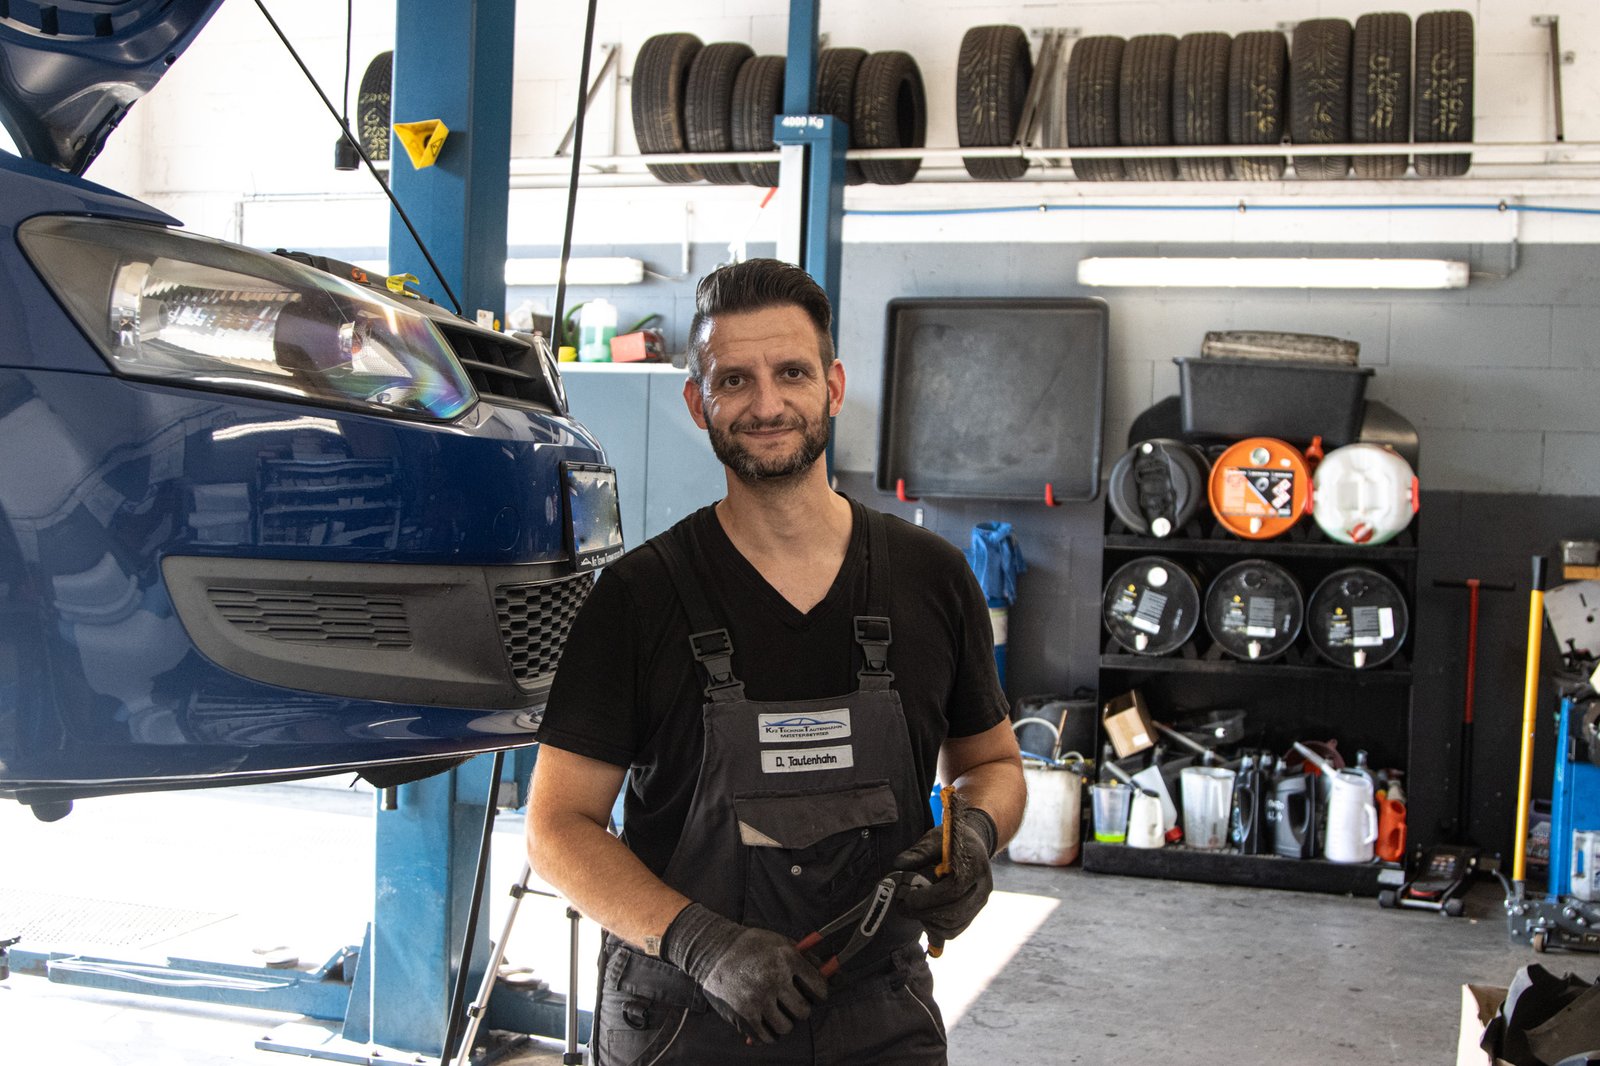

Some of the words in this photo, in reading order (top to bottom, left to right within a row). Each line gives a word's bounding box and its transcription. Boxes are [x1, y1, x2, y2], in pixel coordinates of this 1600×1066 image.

[808, 116, 824, 129] Kg
[776, 757, 785, 767] D.
[788, 754, 837, 767] Tautenhahn
